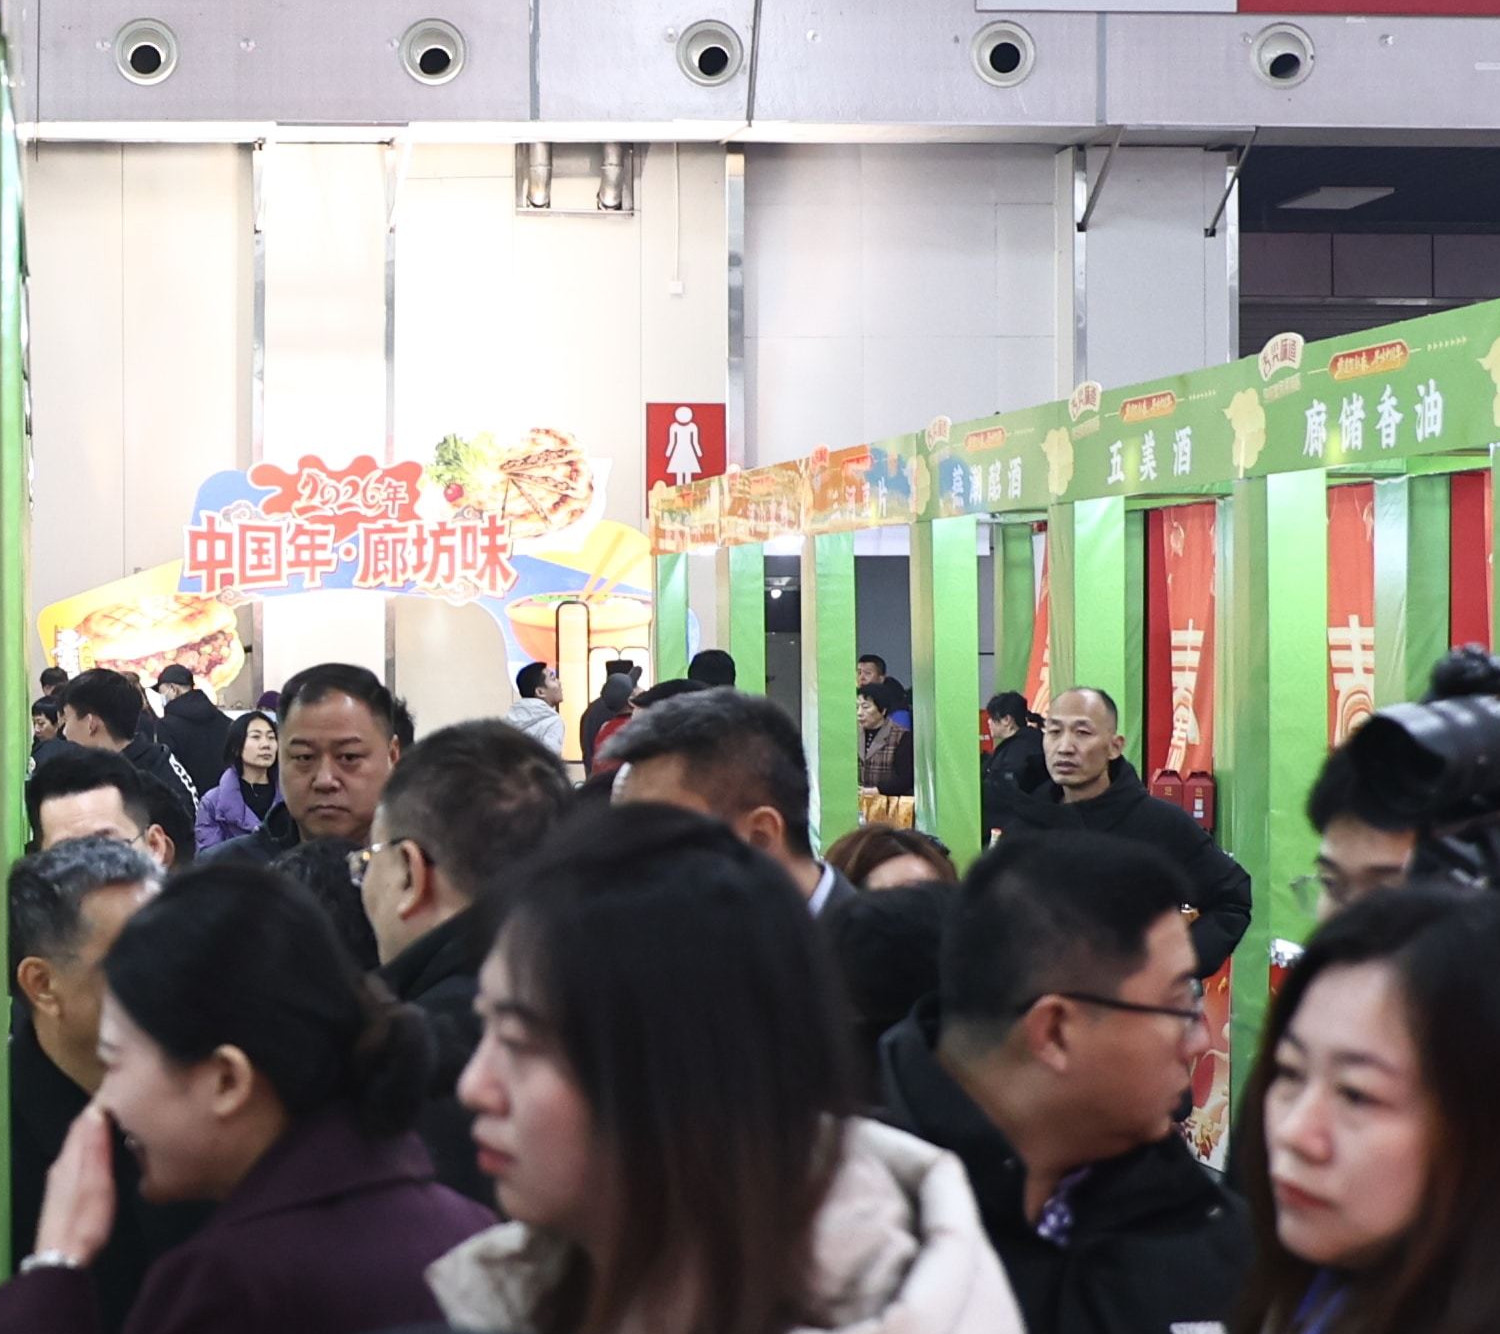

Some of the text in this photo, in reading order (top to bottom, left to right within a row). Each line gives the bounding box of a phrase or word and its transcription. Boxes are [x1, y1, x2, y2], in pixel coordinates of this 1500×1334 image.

[1302, 378, 1443, 458] 廊储香油
[292, 468, 409, 518] 2026年
[183, 514, 517, 597] 中国年·廊坊味
